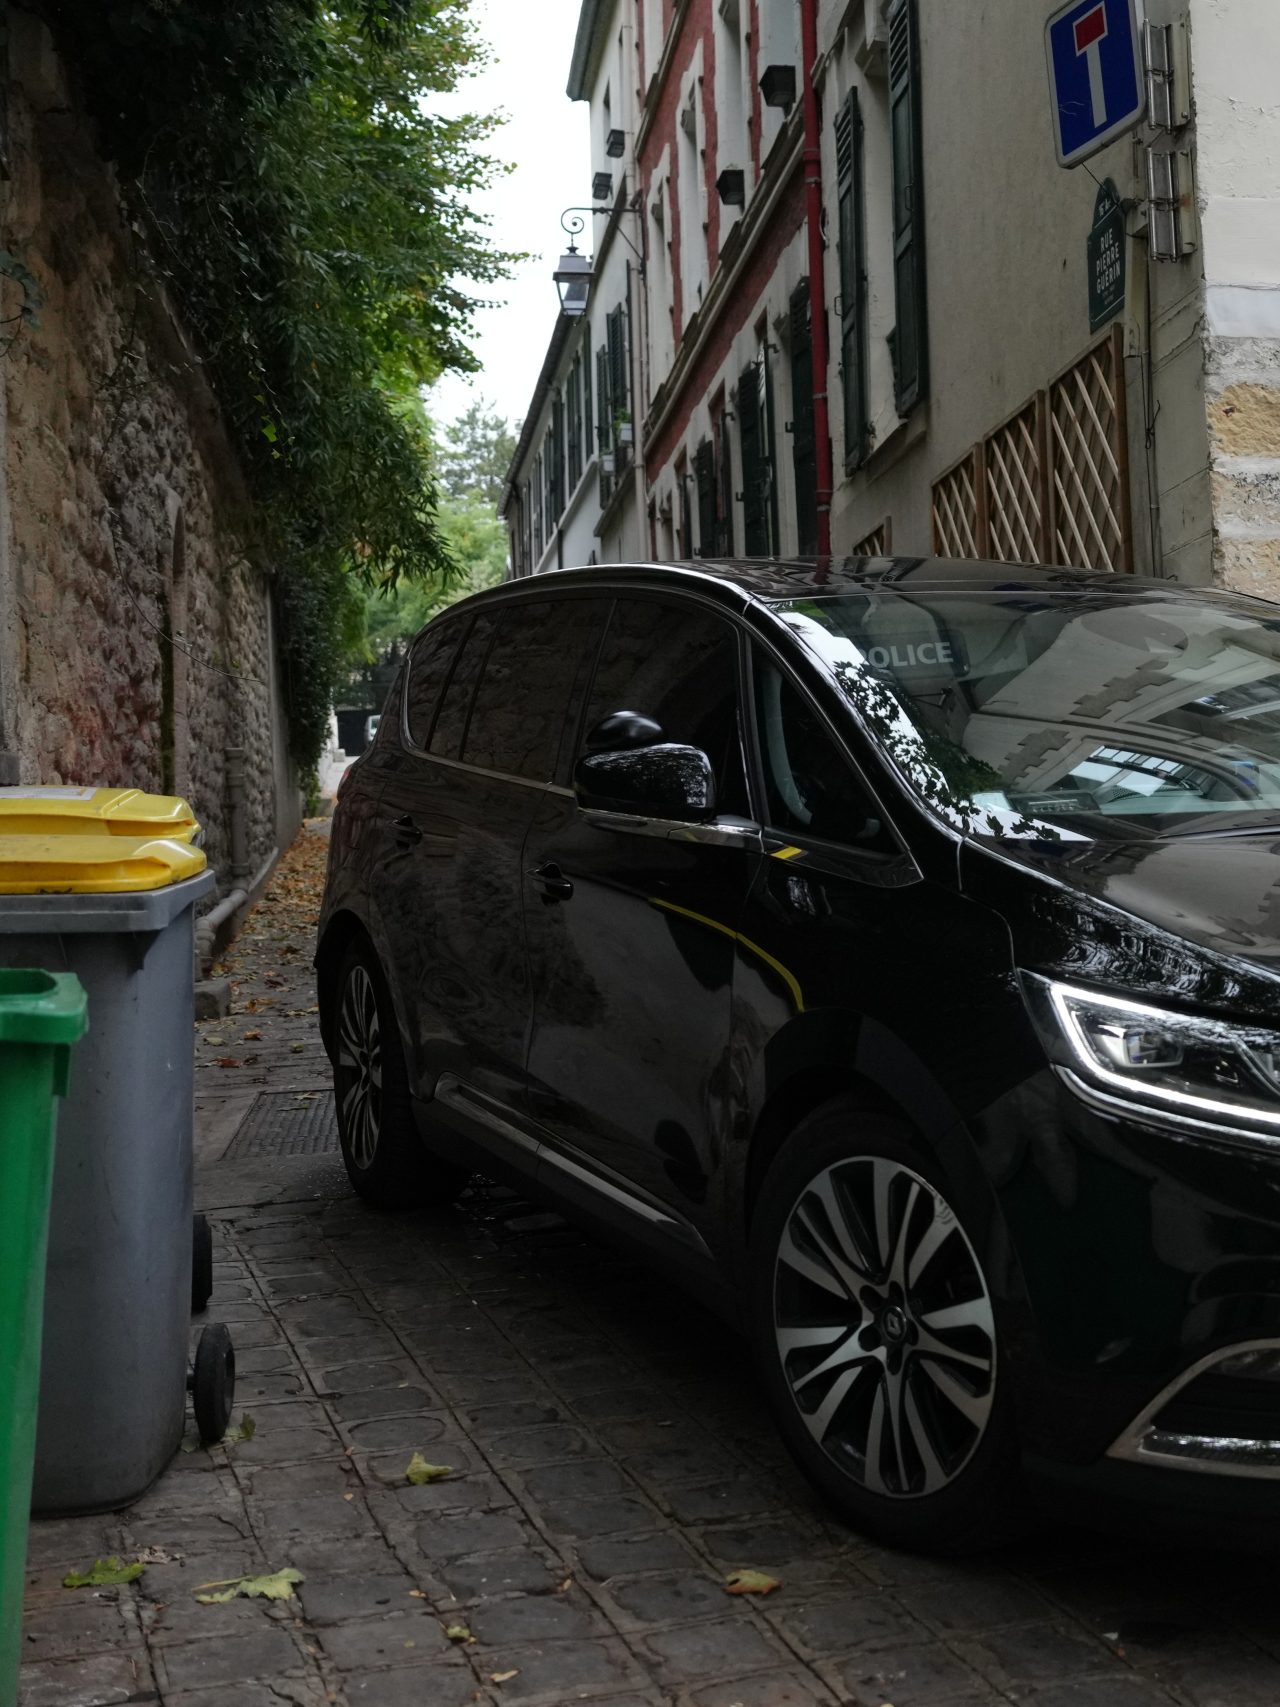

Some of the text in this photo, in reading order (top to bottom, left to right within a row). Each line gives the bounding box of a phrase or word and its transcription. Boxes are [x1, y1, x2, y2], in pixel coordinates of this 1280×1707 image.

[1100, 228, 1113, 254] RUE
[1096, 241, 1119, 277] PIERRE
[863, 641, 954, 668] OLICE
